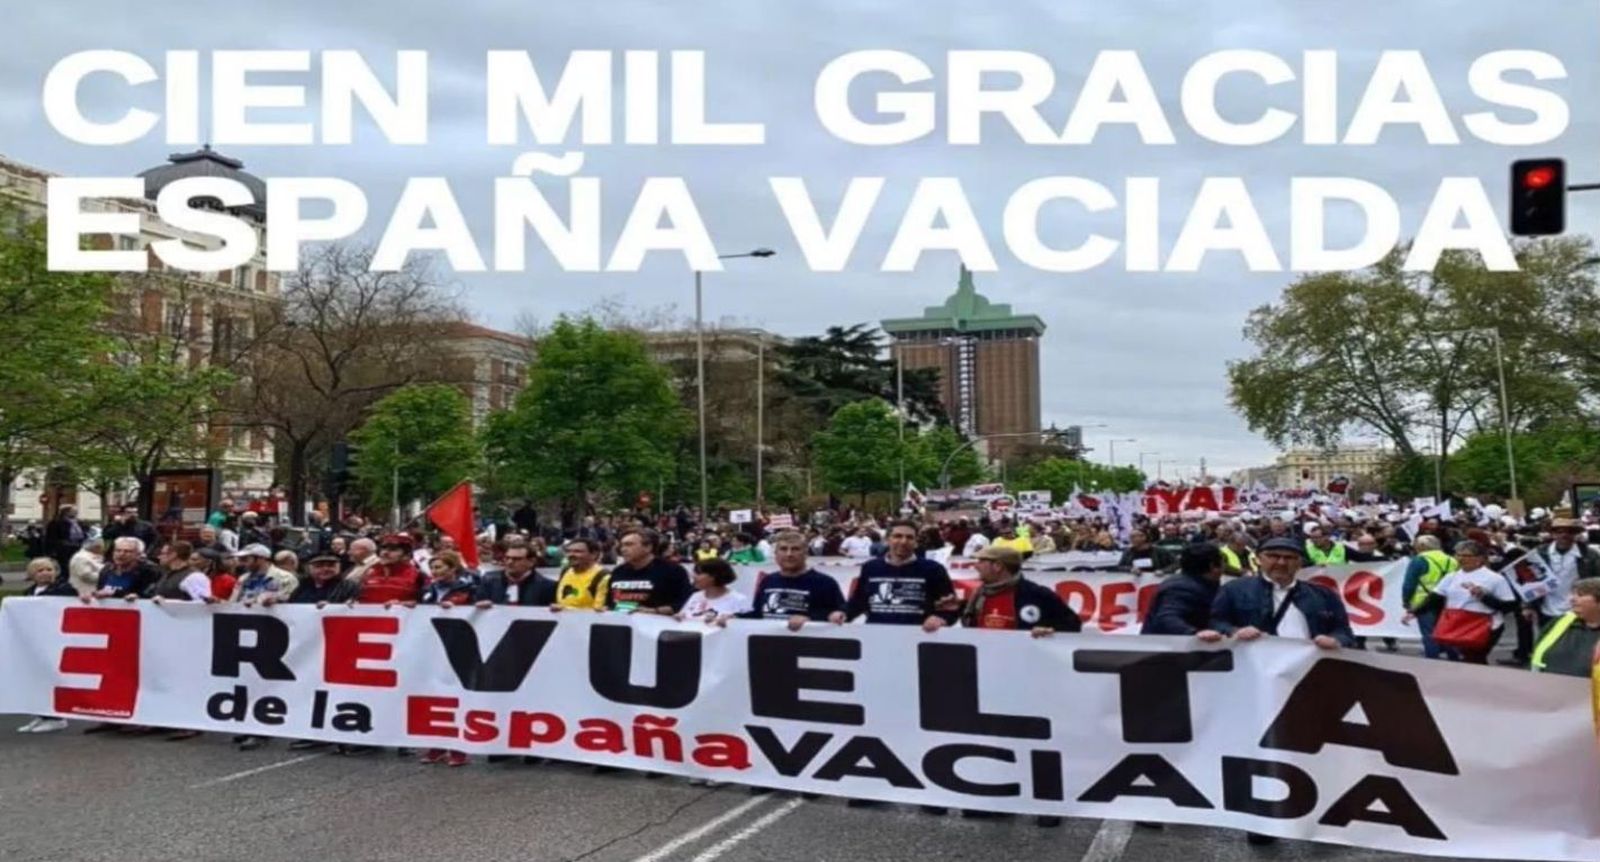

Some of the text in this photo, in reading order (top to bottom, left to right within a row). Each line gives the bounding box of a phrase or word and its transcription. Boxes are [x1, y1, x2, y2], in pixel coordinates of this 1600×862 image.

[206, 685, 288, 725] de
[310, 690, 373, 732] la
[210, 613, 1459, 776] REVUELTA
